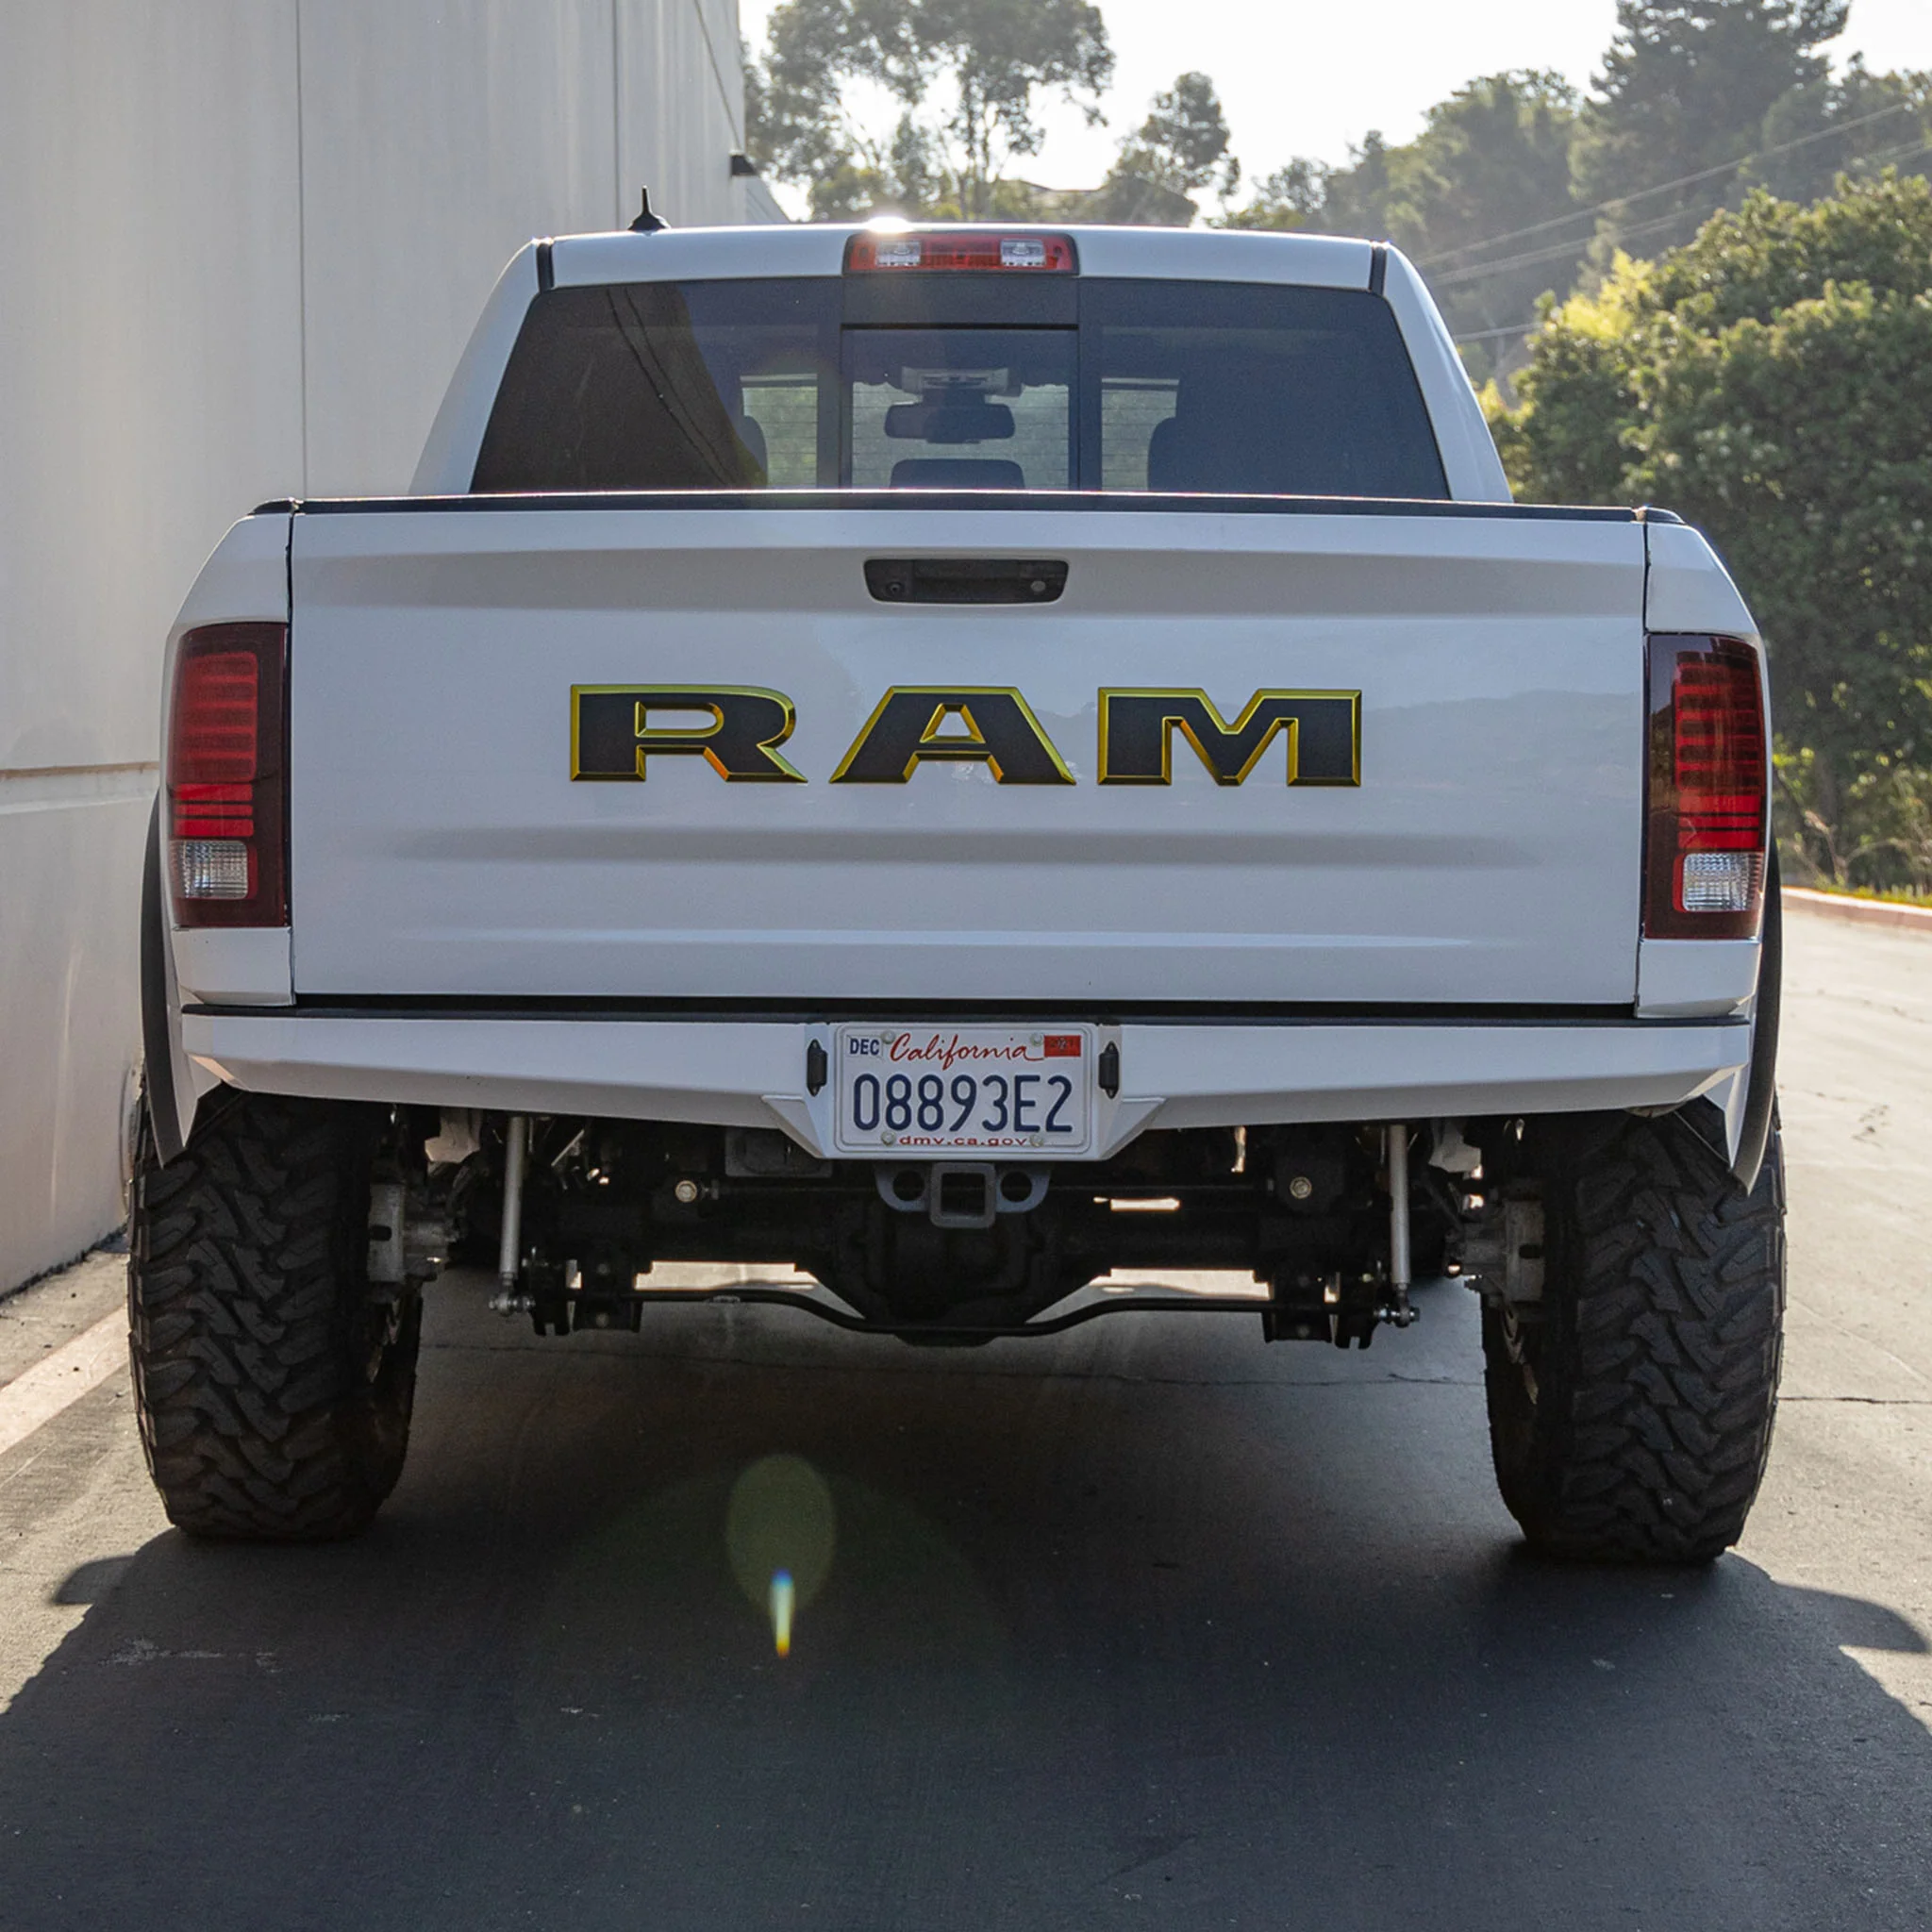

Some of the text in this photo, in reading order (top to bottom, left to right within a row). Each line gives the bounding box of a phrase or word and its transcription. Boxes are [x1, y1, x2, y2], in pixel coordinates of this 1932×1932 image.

[570, 685, 1362, 787] RAM
[849, 1038, 880, 1056] DEC
[890, 1033, 1045, 1071] California
[853, 1074, 1074, 1133] 08893E2
[899, 1135, 1027, 1147] dmv.ca.gov
